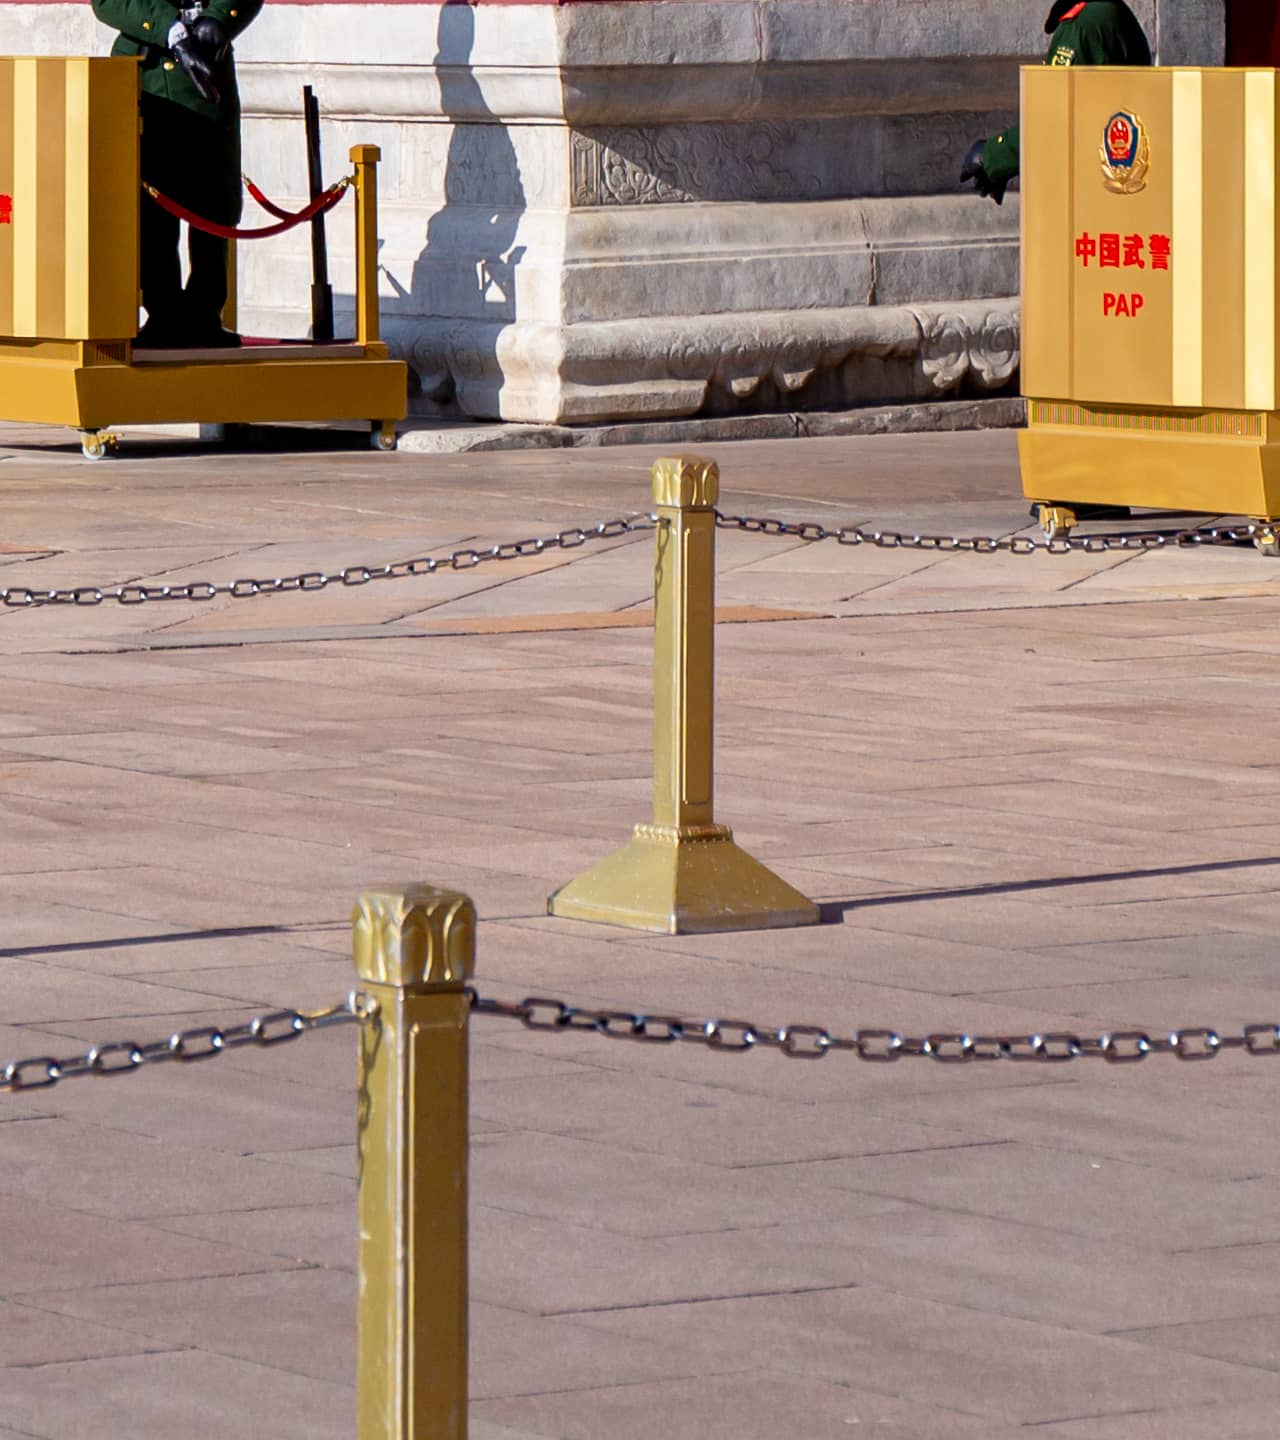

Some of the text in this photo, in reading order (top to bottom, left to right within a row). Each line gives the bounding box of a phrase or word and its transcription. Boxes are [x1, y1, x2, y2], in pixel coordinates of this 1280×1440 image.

[1075, 231, 1171, 271] 中国武警
[1103, 292, 1144, 318] PAP
